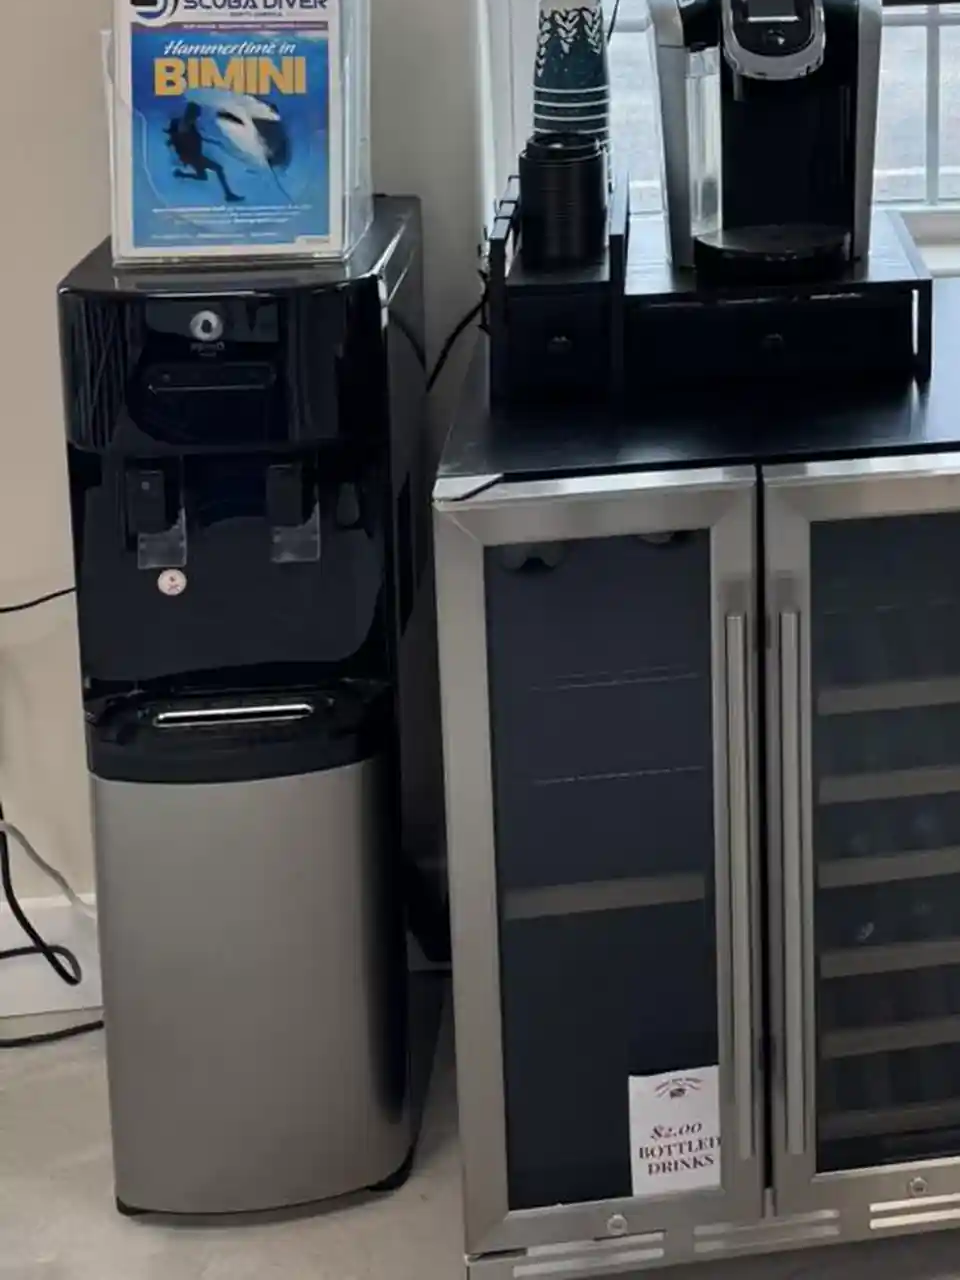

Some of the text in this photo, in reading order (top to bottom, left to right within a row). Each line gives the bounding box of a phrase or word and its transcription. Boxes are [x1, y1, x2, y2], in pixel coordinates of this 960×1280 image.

[163, 39, 297, 56] Hammertime in
[154, 56, 307, 96] BIMINI
[650, 1122, 703, 1141] $2.00
[638, 1136, 721, 1160] BOTTLED
[647, 1154, 715, 1176] DRINKS
